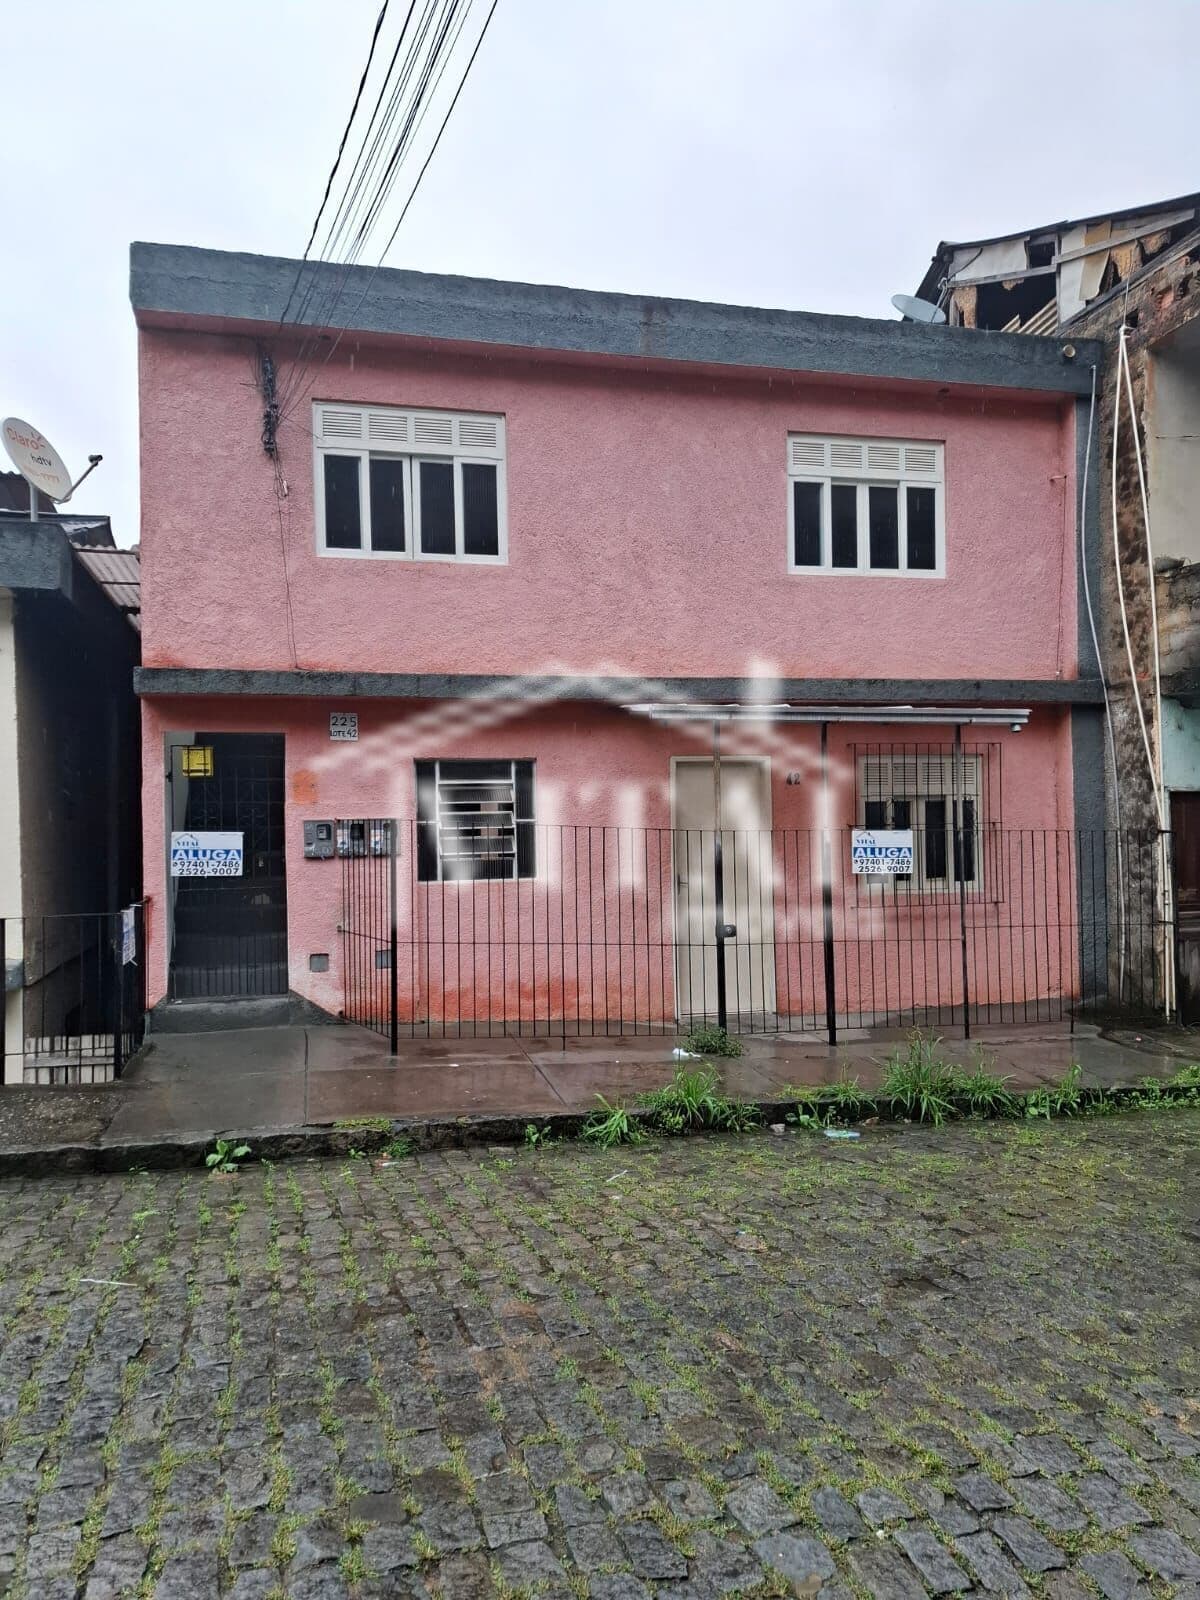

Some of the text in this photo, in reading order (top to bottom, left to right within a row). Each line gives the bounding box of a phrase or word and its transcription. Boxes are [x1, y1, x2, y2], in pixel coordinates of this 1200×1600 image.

[7, 427, 39, 450] Claro
[30, 453, 52, 466] hdtv
[331, 716, 357, 727] 225
[346, 729, 357, 738] 42
[174, 850, 240, 860] ALUGA
[855, 848, 911, 857] ALUGA
[178, 867, 239, 875] 2526-9007
